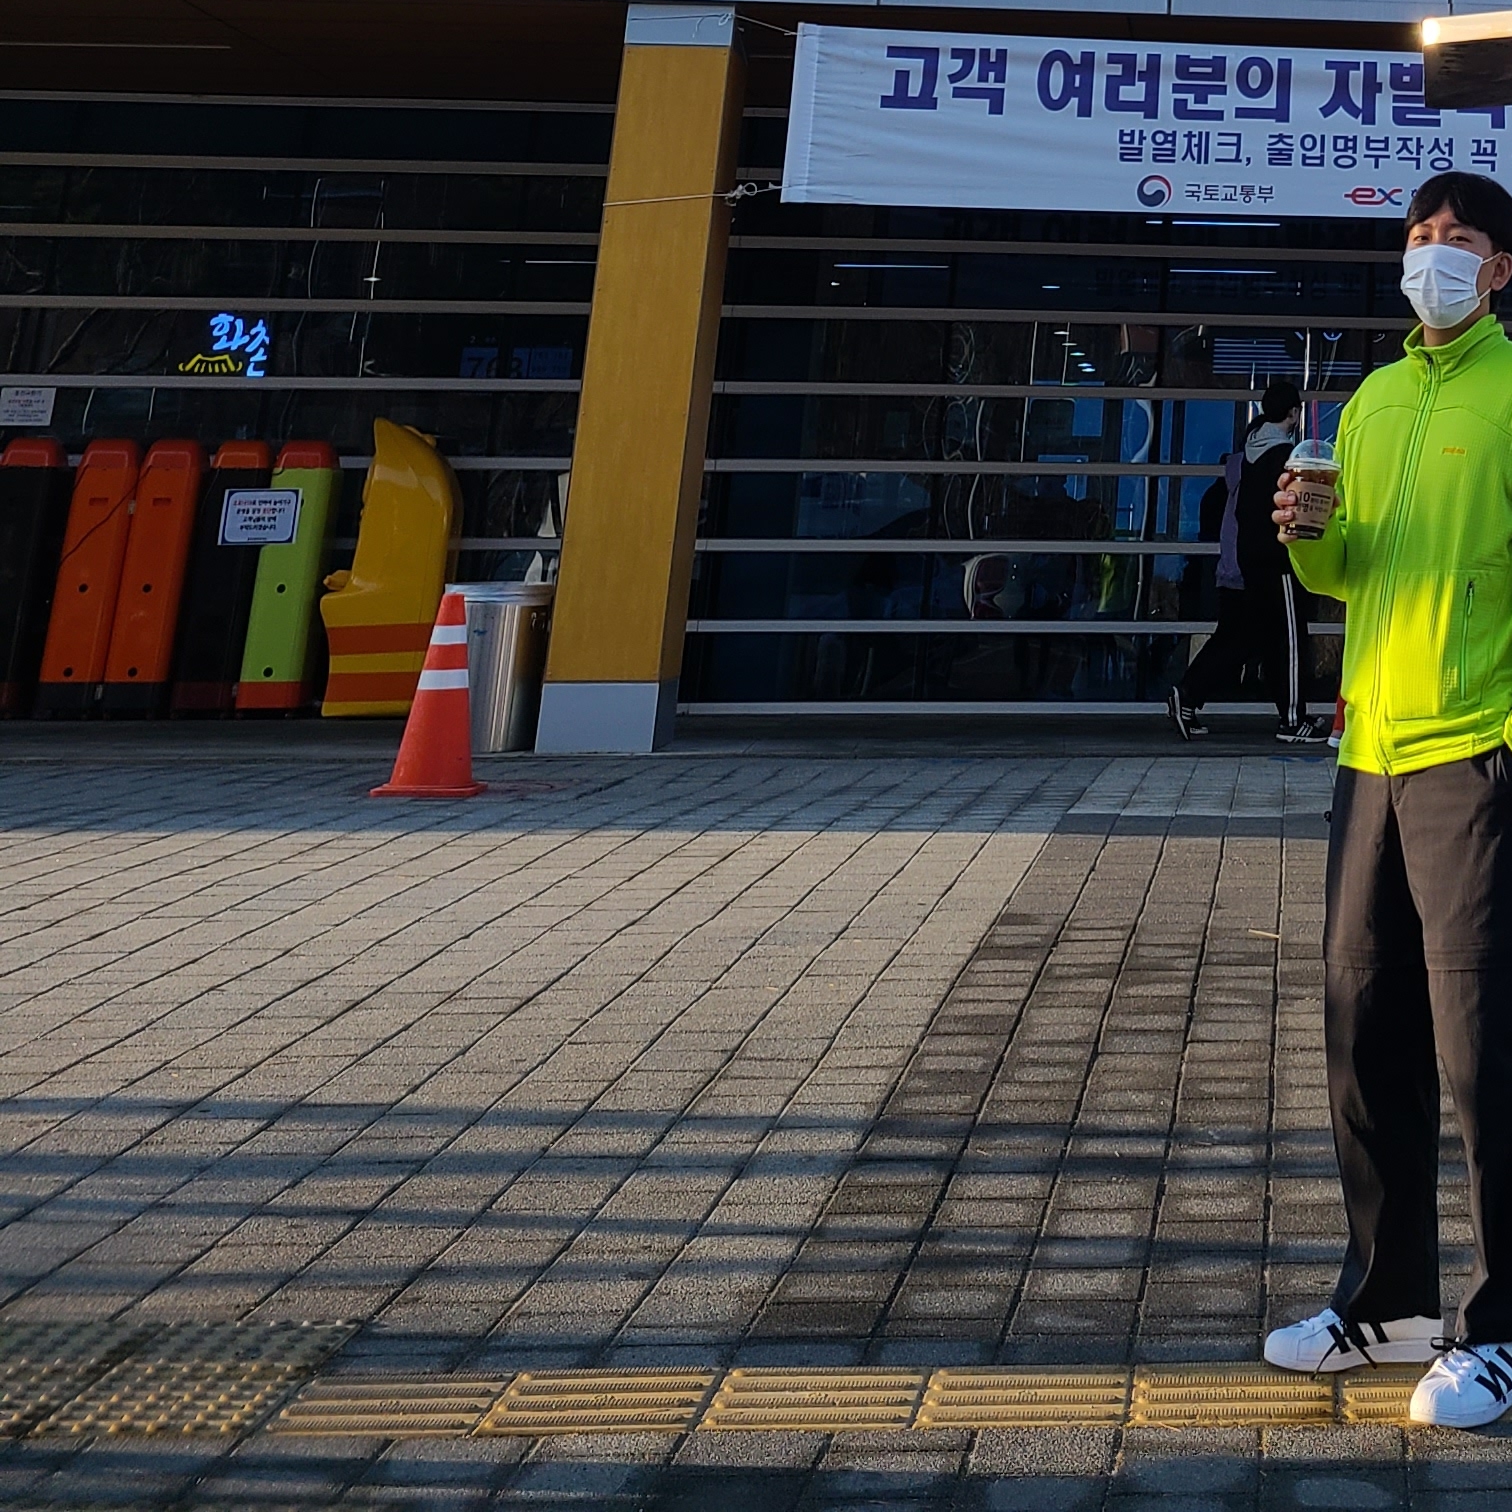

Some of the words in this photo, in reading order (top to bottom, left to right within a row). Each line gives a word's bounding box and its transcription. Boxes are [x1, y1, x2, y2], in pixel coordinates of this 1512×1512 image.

[879, 45, 1008, 116] 고객
[1036, 49, 1293, 124] 여러분의
[1318, 60, 1505, 130] 자발
[1118, 129, 1252, 167] 발열체크,
[1266, 133, 1455, 172] 출입명부작성
[1470, 139, 1498, 173] 꼭
[1184, 183, 1275, 204] 국토교통부
